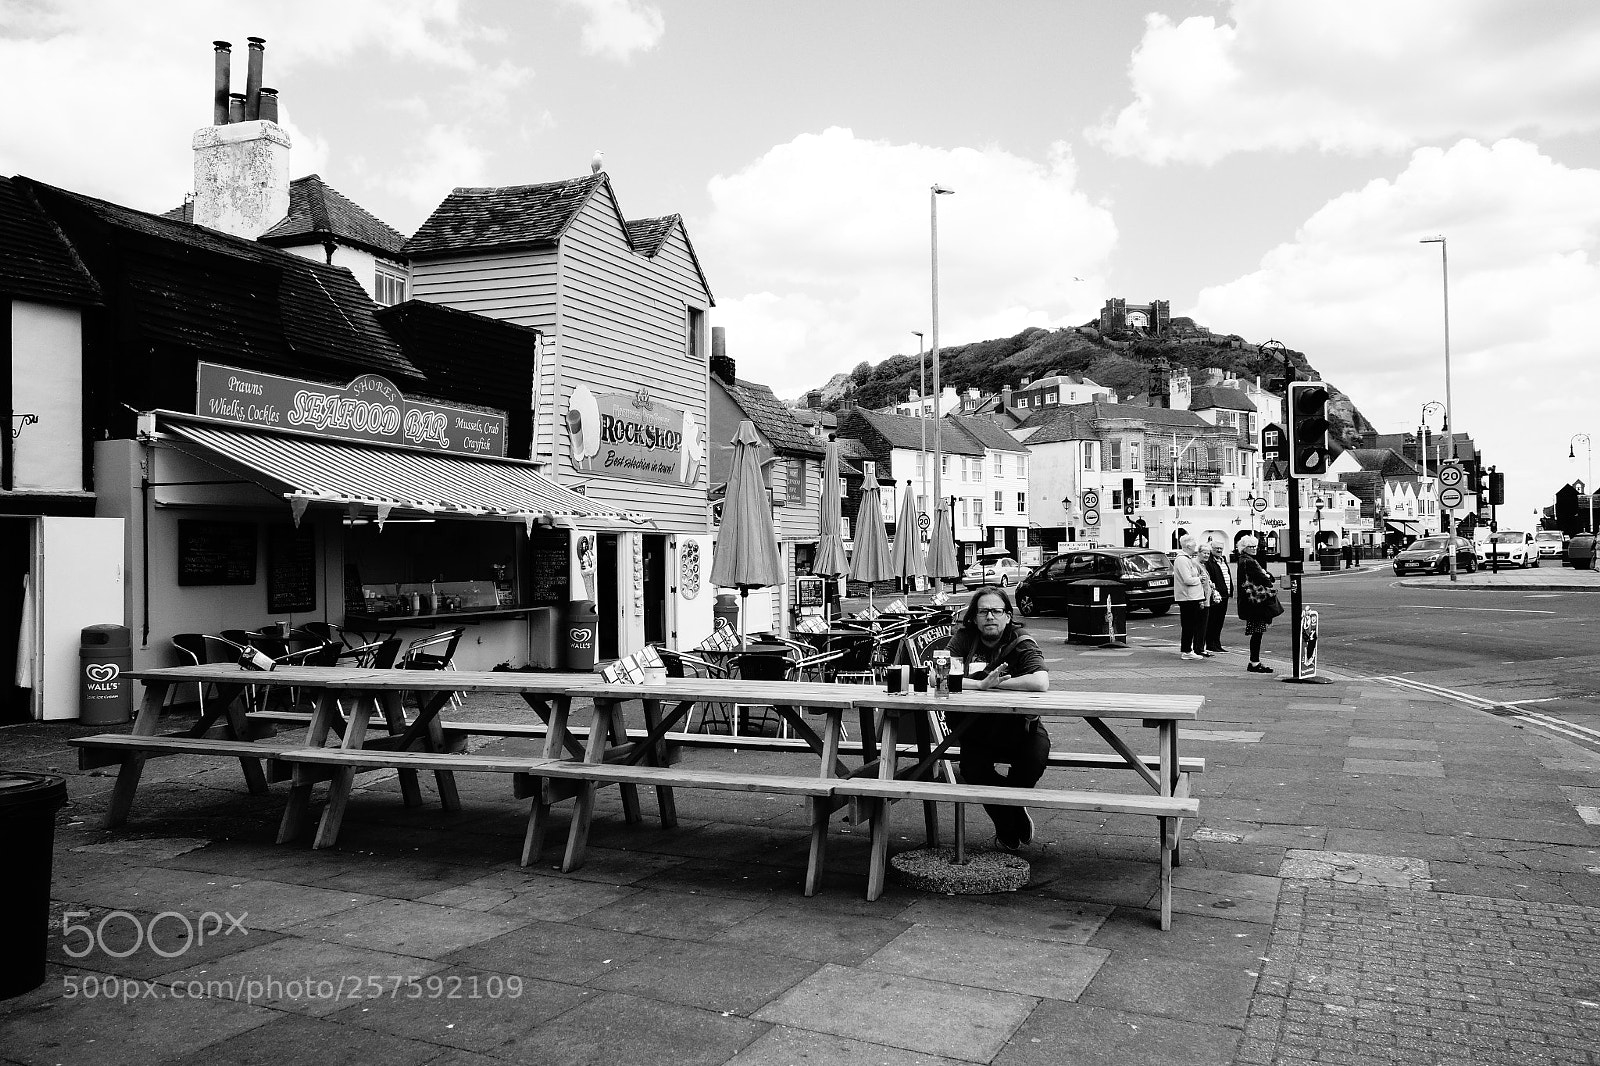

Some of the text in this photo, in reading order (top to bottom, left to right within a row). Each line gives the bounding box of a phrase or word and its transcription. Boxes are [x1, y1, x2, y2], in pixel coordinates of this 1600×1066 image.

[228, 376, 263, 395] Prawns
[353, 377, 397, 402] SHORES
[209, 397, 280, 425] Whelks, Cockles
[287, 390, 450, 448] SEAFOOD BAR
[455, 418, 500, 435] Mussels, Crab
[601, 413, 646, 447] ROCK
[646, 424, 683, 453] SHOP
[463, 437, 491, 453] Crayfish
[604, 449, 676, 475] Best selection in town!
[1442, 472, 1459, 481] 20
[1085, 496, 1097, 504] 20
[919, 518, 929, 526] 20
[917, 625, 952, 649] FRESHLY
[87, 682, 118, 691] WALL'S
